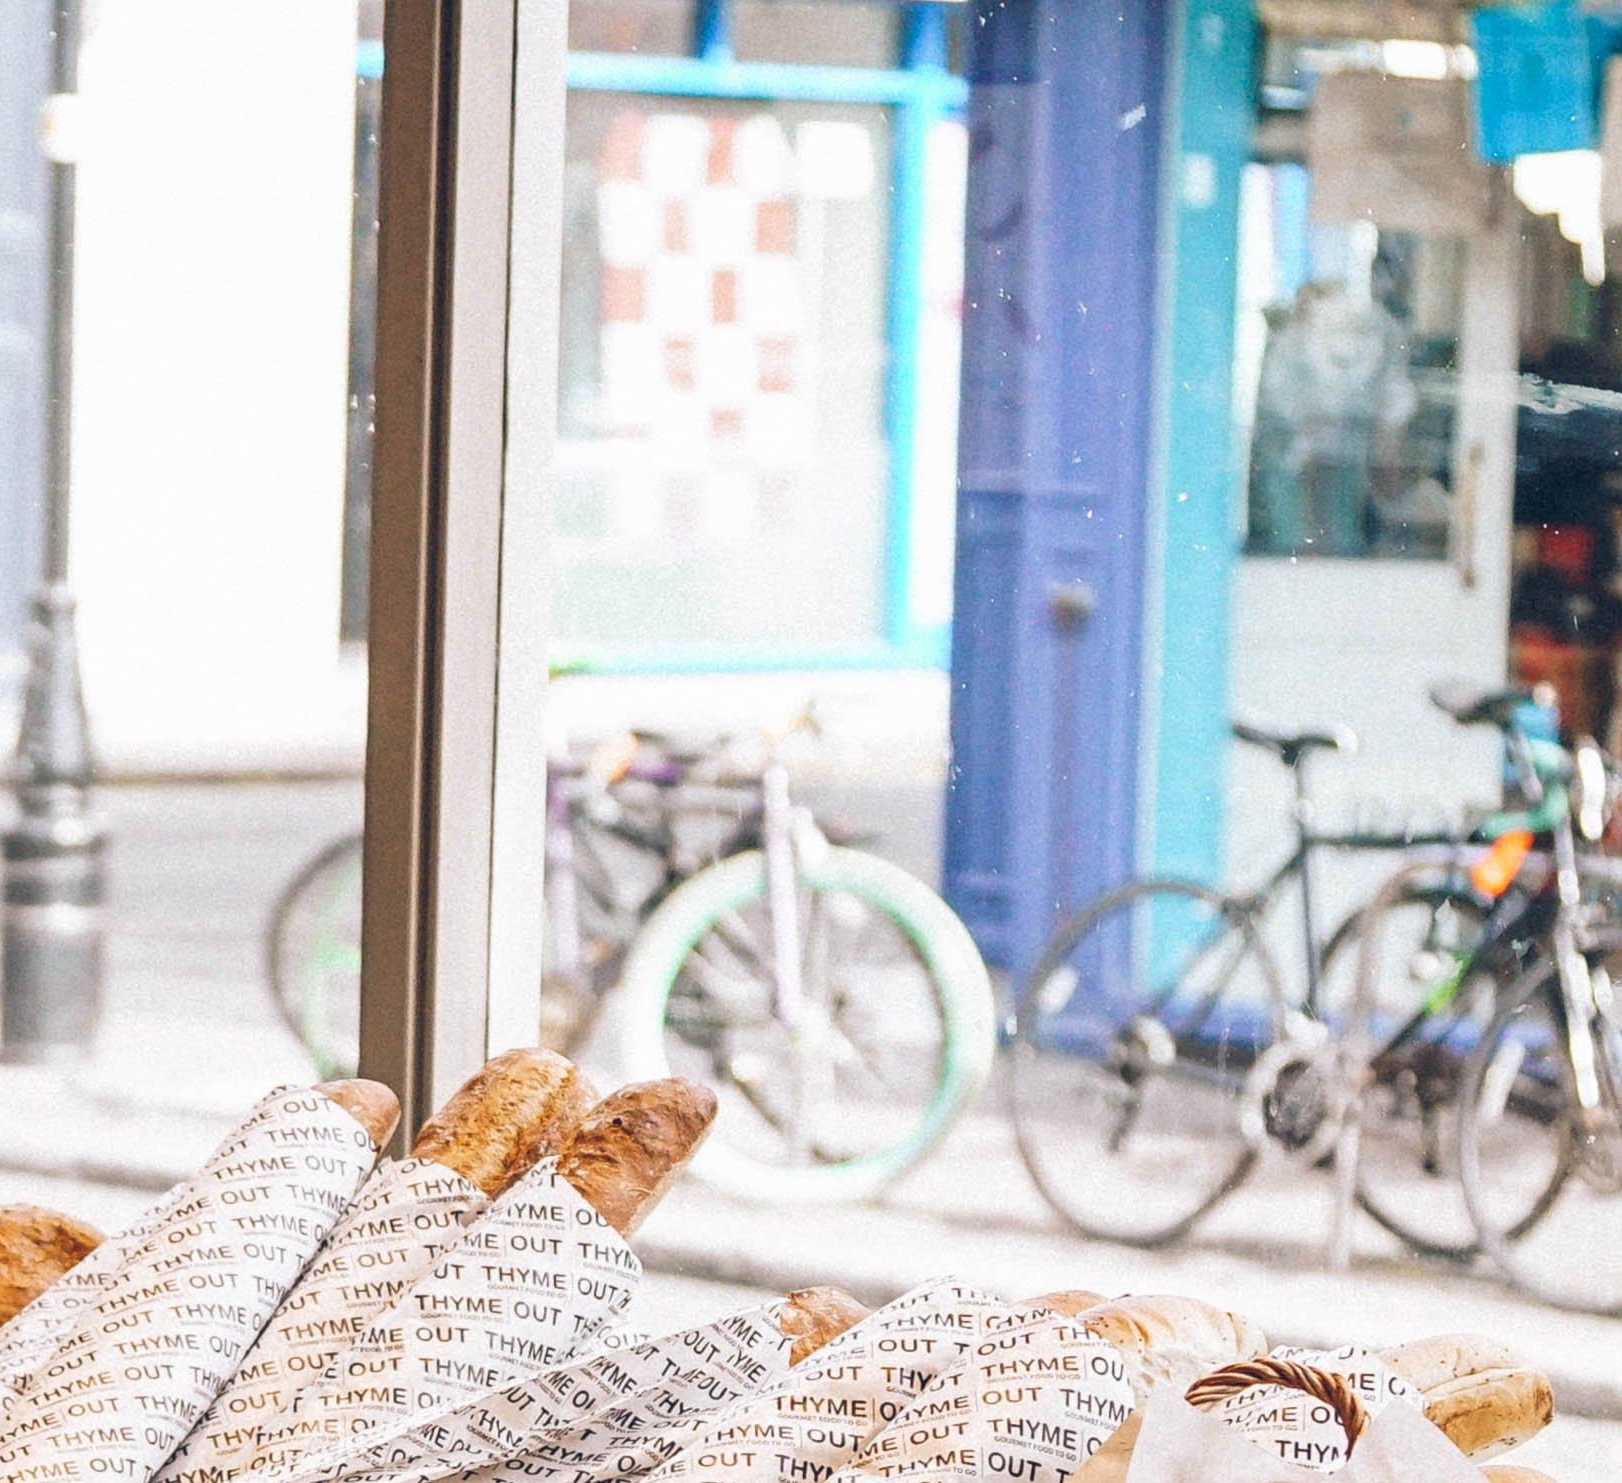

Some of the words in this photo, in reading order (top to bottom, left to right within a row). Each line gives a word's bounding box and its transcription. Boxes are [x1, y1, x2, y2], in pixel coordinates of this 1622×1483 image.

[266, 1127, 343, 1144] THYME
[211, 1156, 297, 1180] THYME
[305, 1155, 347, 1177] OUT
[221, 1186, 271, 1203] OUT
[168, 1221, 217, 1244] OUT
[232, 1214, 308, 1238] THYME
[414, 1210, 464, 1230] OUT
[511, 1235, 563, 1255] OUT
[150, 1246, 235, 1273] THYME
[243, 1243, 288, 1264] OUT
[358, 1249, 408, 1268] OUT
[95, 1281, 178, 1314] THYME
[189, 1273, 239, 1289] OUT
[481, 1265, 567, 1290] THYME
[578, 1277, 619, 1301] OUT
[102, 1311, 155, 1334] OUT
[170, 1304, 247, 1326] THYME
[415, 1294, 503, 1315] THYME
[514, 1301, 562, 1326] OUT
[279, 1317, 365, 1341] THYME
[881, 1313, 974, 1330] THYME
[114, 1333, 197, 1355] THYME
[209, 1336, 242, 1361] OUT
[415, 1327, 469, 1343] OUT
[484, 1330, 555, 1365] THYME
[684, 1330, 720, 1363] OUT
[879, 1338, 937, 1352] OUT
[977, 1332, 1036, 1356] OUT
[47, 1352, 98, 1378] OUT
[287, 1352, 339, 1371] OUT
[348, 1357, 402, 1377] OUT
[419, 1357, 499, 1388] THYME
[980, 1356, 1078, 1377] THYME
[805, 1367, 862, 1381] OUT
[29, 1372, 113, 1407] THYME
[124, 1364, 175, 1381] OUT
[318, 1387, 407, 1406] THYME
[982, 1387, 1042, 1405] OUT
[68, 1398, 120, 1418] OUT
[229, 1391, 282, 1413] OUT
[773, 1397, 867, 1418] THYME
[47, 1427, 136, 1448] THYME
[145, 1427, 175, 1451] OUT
[807, 1429, 865, 1451] OUT
[910, 1422, 969, 1445] OUT
[986, 1418, 1077, 1450] THYME
[89, 1457, 137, 1477] OUT
[504, 1458, 562, 1479] OUT
[698, 1453, 756, 1467] OUT
[878, 1449, 977, 1477] THYME
[988, 1452, 1042, 1482] OUT
